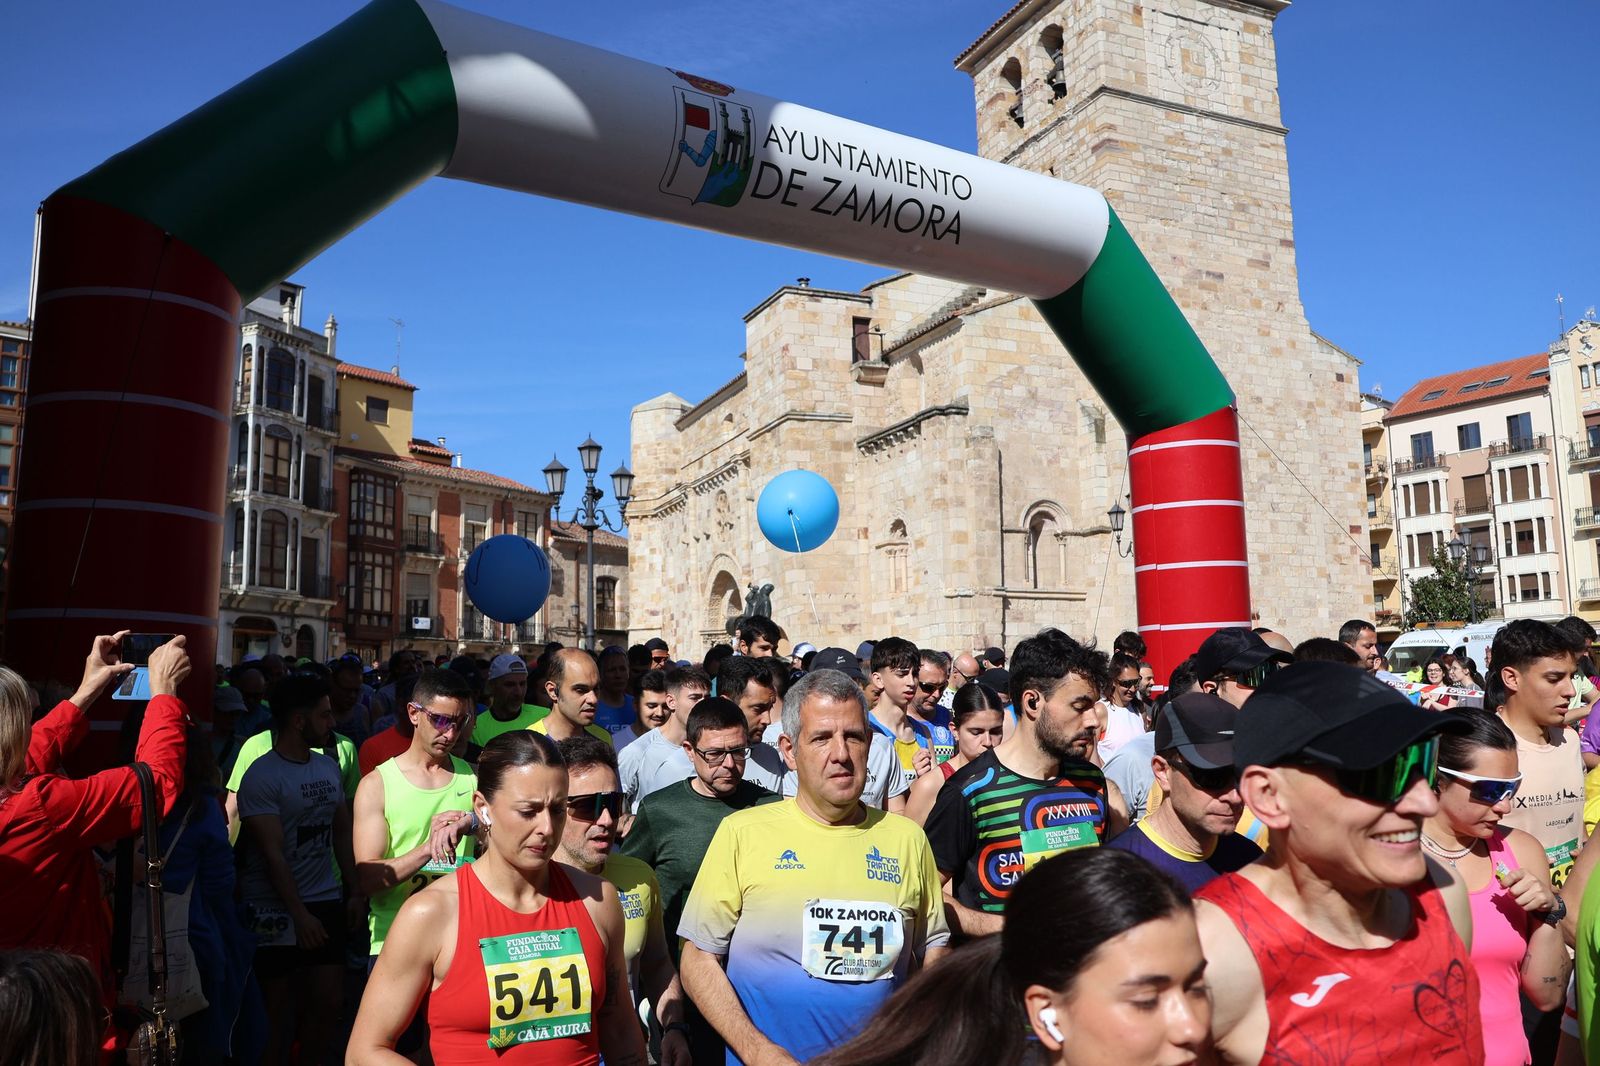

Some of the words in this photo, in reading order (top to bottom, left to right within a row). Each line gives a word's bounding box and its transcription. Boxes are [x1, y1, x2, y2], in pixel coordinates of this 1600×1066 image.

[763, 124, 972, 201] AYUNTAMIENTO
[750, 161, 807, 207] DE
[810, 177, 961, 245] ZAMORA
[1528, 794, 1553, 802] MEDIA
[1045, 803, 1092, 820] XXXVIII
[866, 869, 901, 884] DUERO
[624, 908, 645, 919] UERO
[809, 907, 834, 919] 10K
[837, 908, 897, 922] ZAMORA
[818, 923, 884, 954] 741
[508, 946, 531, 956] CAJA
[533, 942, 562, 951] RURAL
[843, 958, 856, 967] CLUB
[857, 959, 882, 968] ATLETISMO
[843, 966, 864, 975] ZAMORA
[494, 963, 582, 1021] 541
[517, 1027, 551, 1042] CAJA
[553, 1022, 591, 1037] RURA
